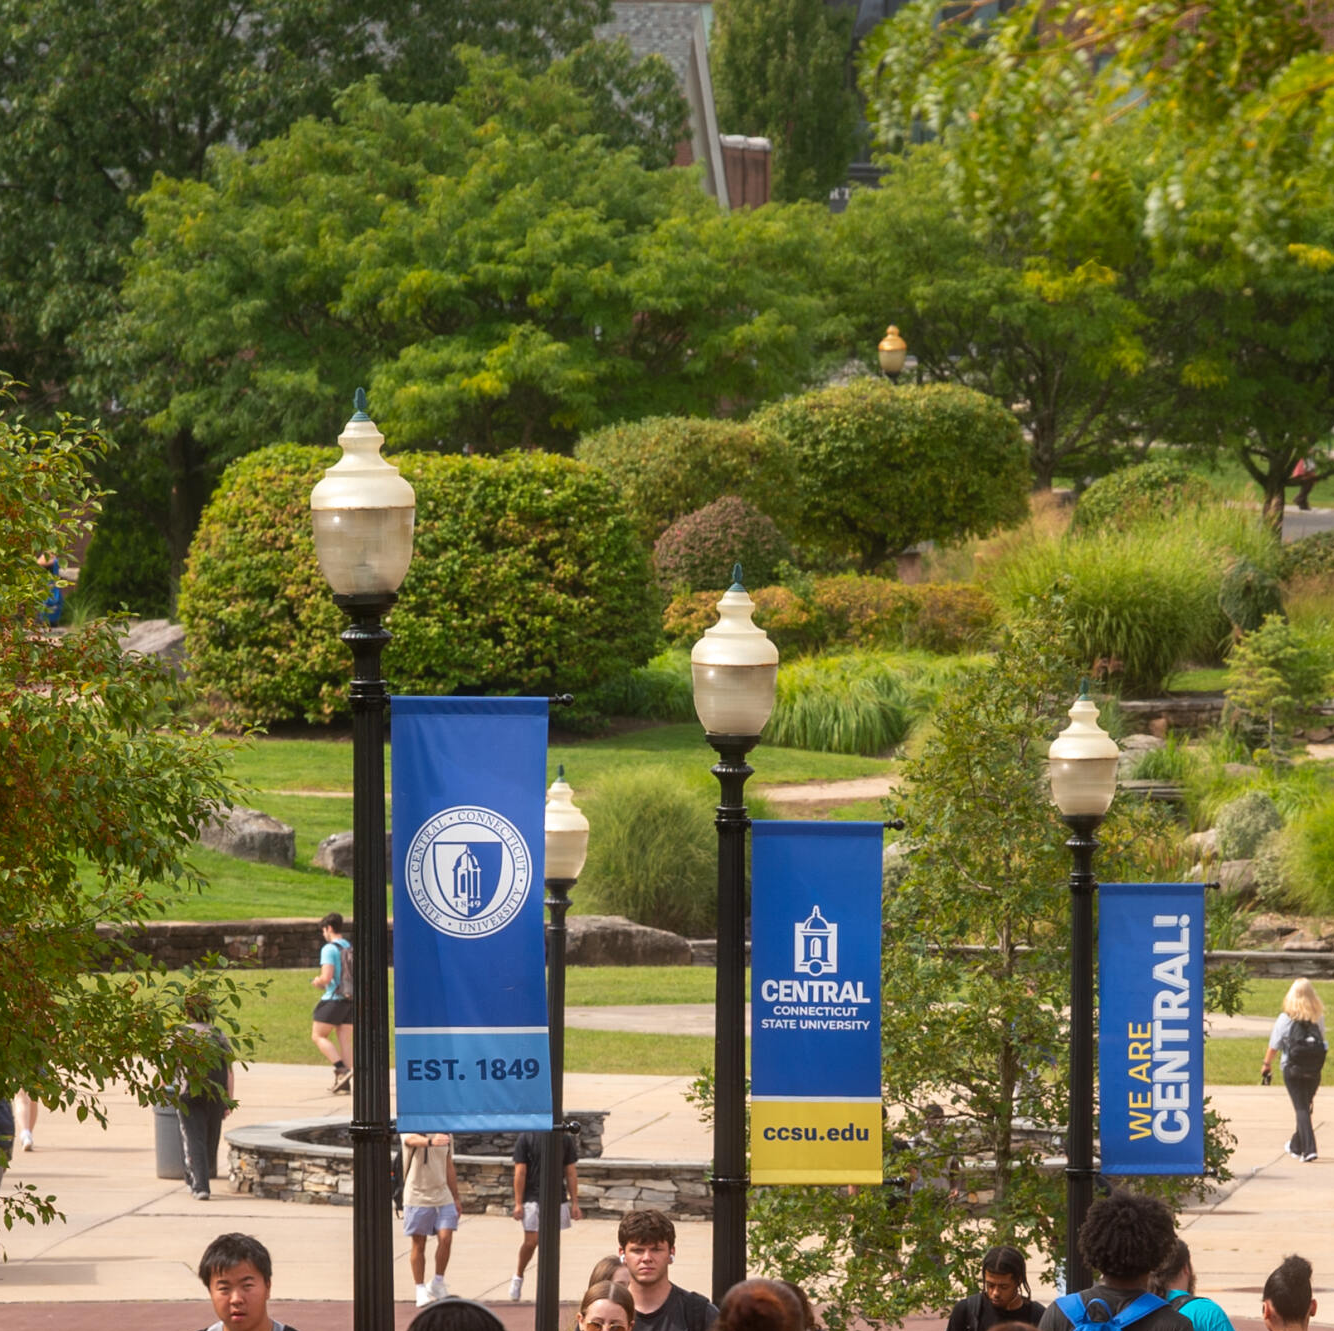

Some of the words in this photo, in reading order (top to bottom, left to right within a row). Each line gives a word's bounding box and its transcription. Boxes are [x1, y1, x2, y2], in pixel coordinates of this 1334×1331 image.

[411, 818, 447, 873] CENTRAL
[457, 811, 527, 874] CONNECTICUT
[413, 888, 442, 924] STATE
[458, 888, 523, 933] UNIVERSITY
[454, 900, 482, 909] 1849
[761, 979, 871, 1004] CENTRAL
[773, 1005, 859, 1017] CONNECTICUT
[761, 1018, 797, 1029] STATE
[799, 1019, 871, 1031] UNIVERSITY
[1152, 914, 1191, 1144] CENTRAL!
[1128, 1021, 1153, 1084] ARE
[407, 1059, 465, 1081] EST.
[475, 1058, 540, 1081] 1849
[1128, 1091, 1153, 1141] WE
[763, 1122, 870, 1142] ccsu.edu
